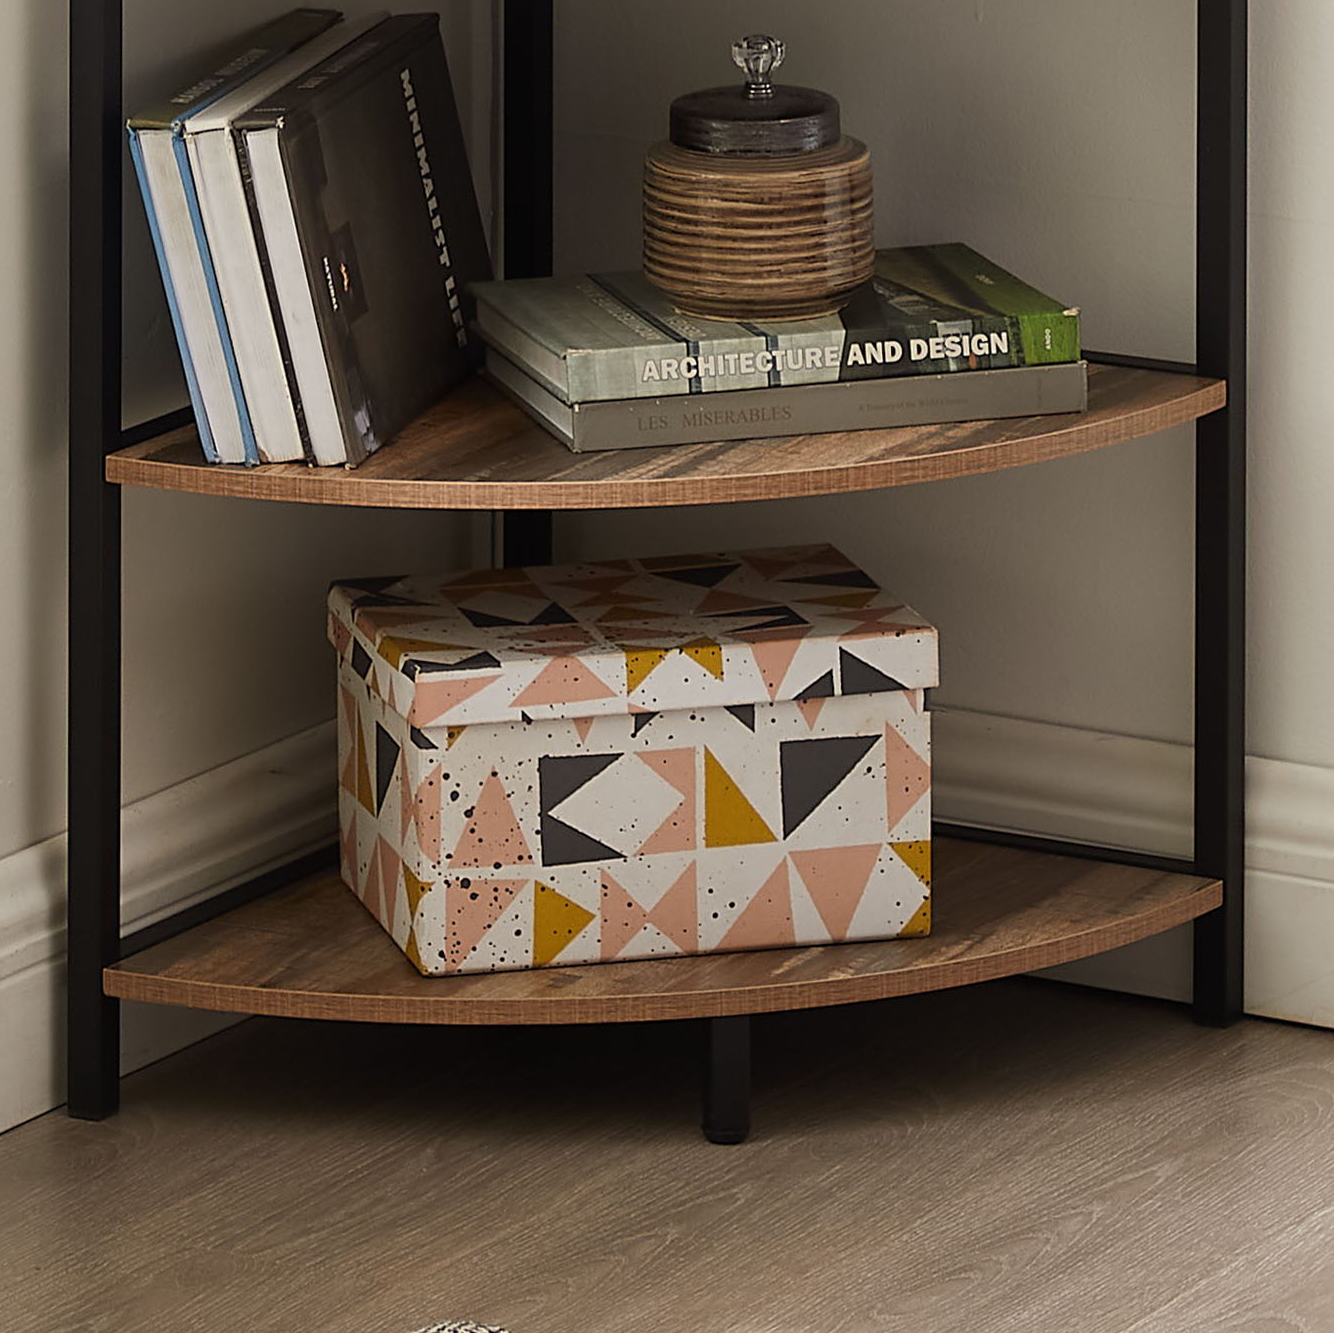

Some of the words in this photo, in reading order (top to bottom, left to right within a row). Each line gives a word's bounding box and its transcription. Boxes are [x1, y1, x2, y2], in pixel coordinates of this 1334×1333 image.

[400, 68, 451, 268] MINIMALIST
[444, 275, 468, 349] LIFE
[642, 345, 841, 382] ARCHITECTURE
[847, 341, 903, 367] AND
[910, 332, 1009, 361] DESIGN
[637, 415, 668, 431] LES
[682, 406, 793, 428] MISERABLES
